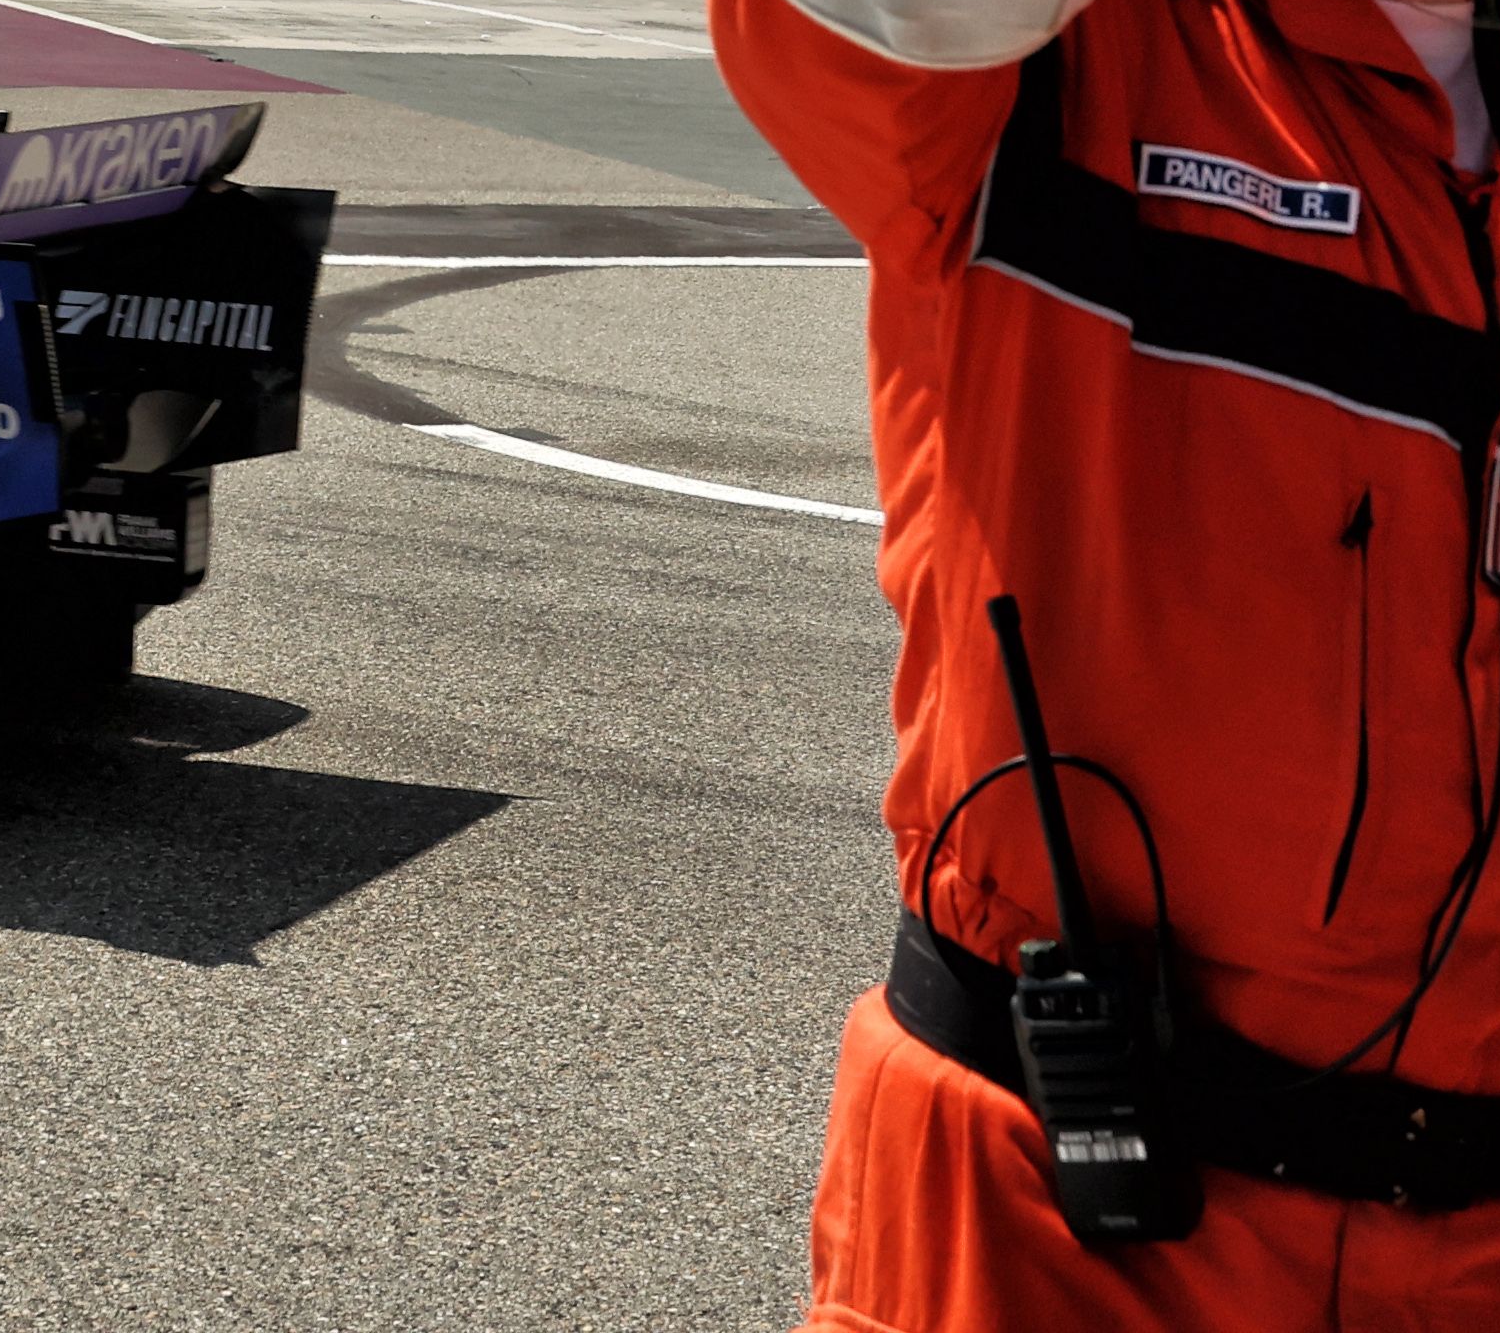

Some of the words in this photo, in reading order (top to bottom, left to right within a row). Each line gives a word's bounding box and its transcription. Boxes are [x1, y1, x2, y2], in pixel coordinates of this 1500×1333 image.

[46, 111, 217, 205] kraken
[1164, 157, 1291, 215] PANGERL
[1301, 192, 1331, 218] R.
